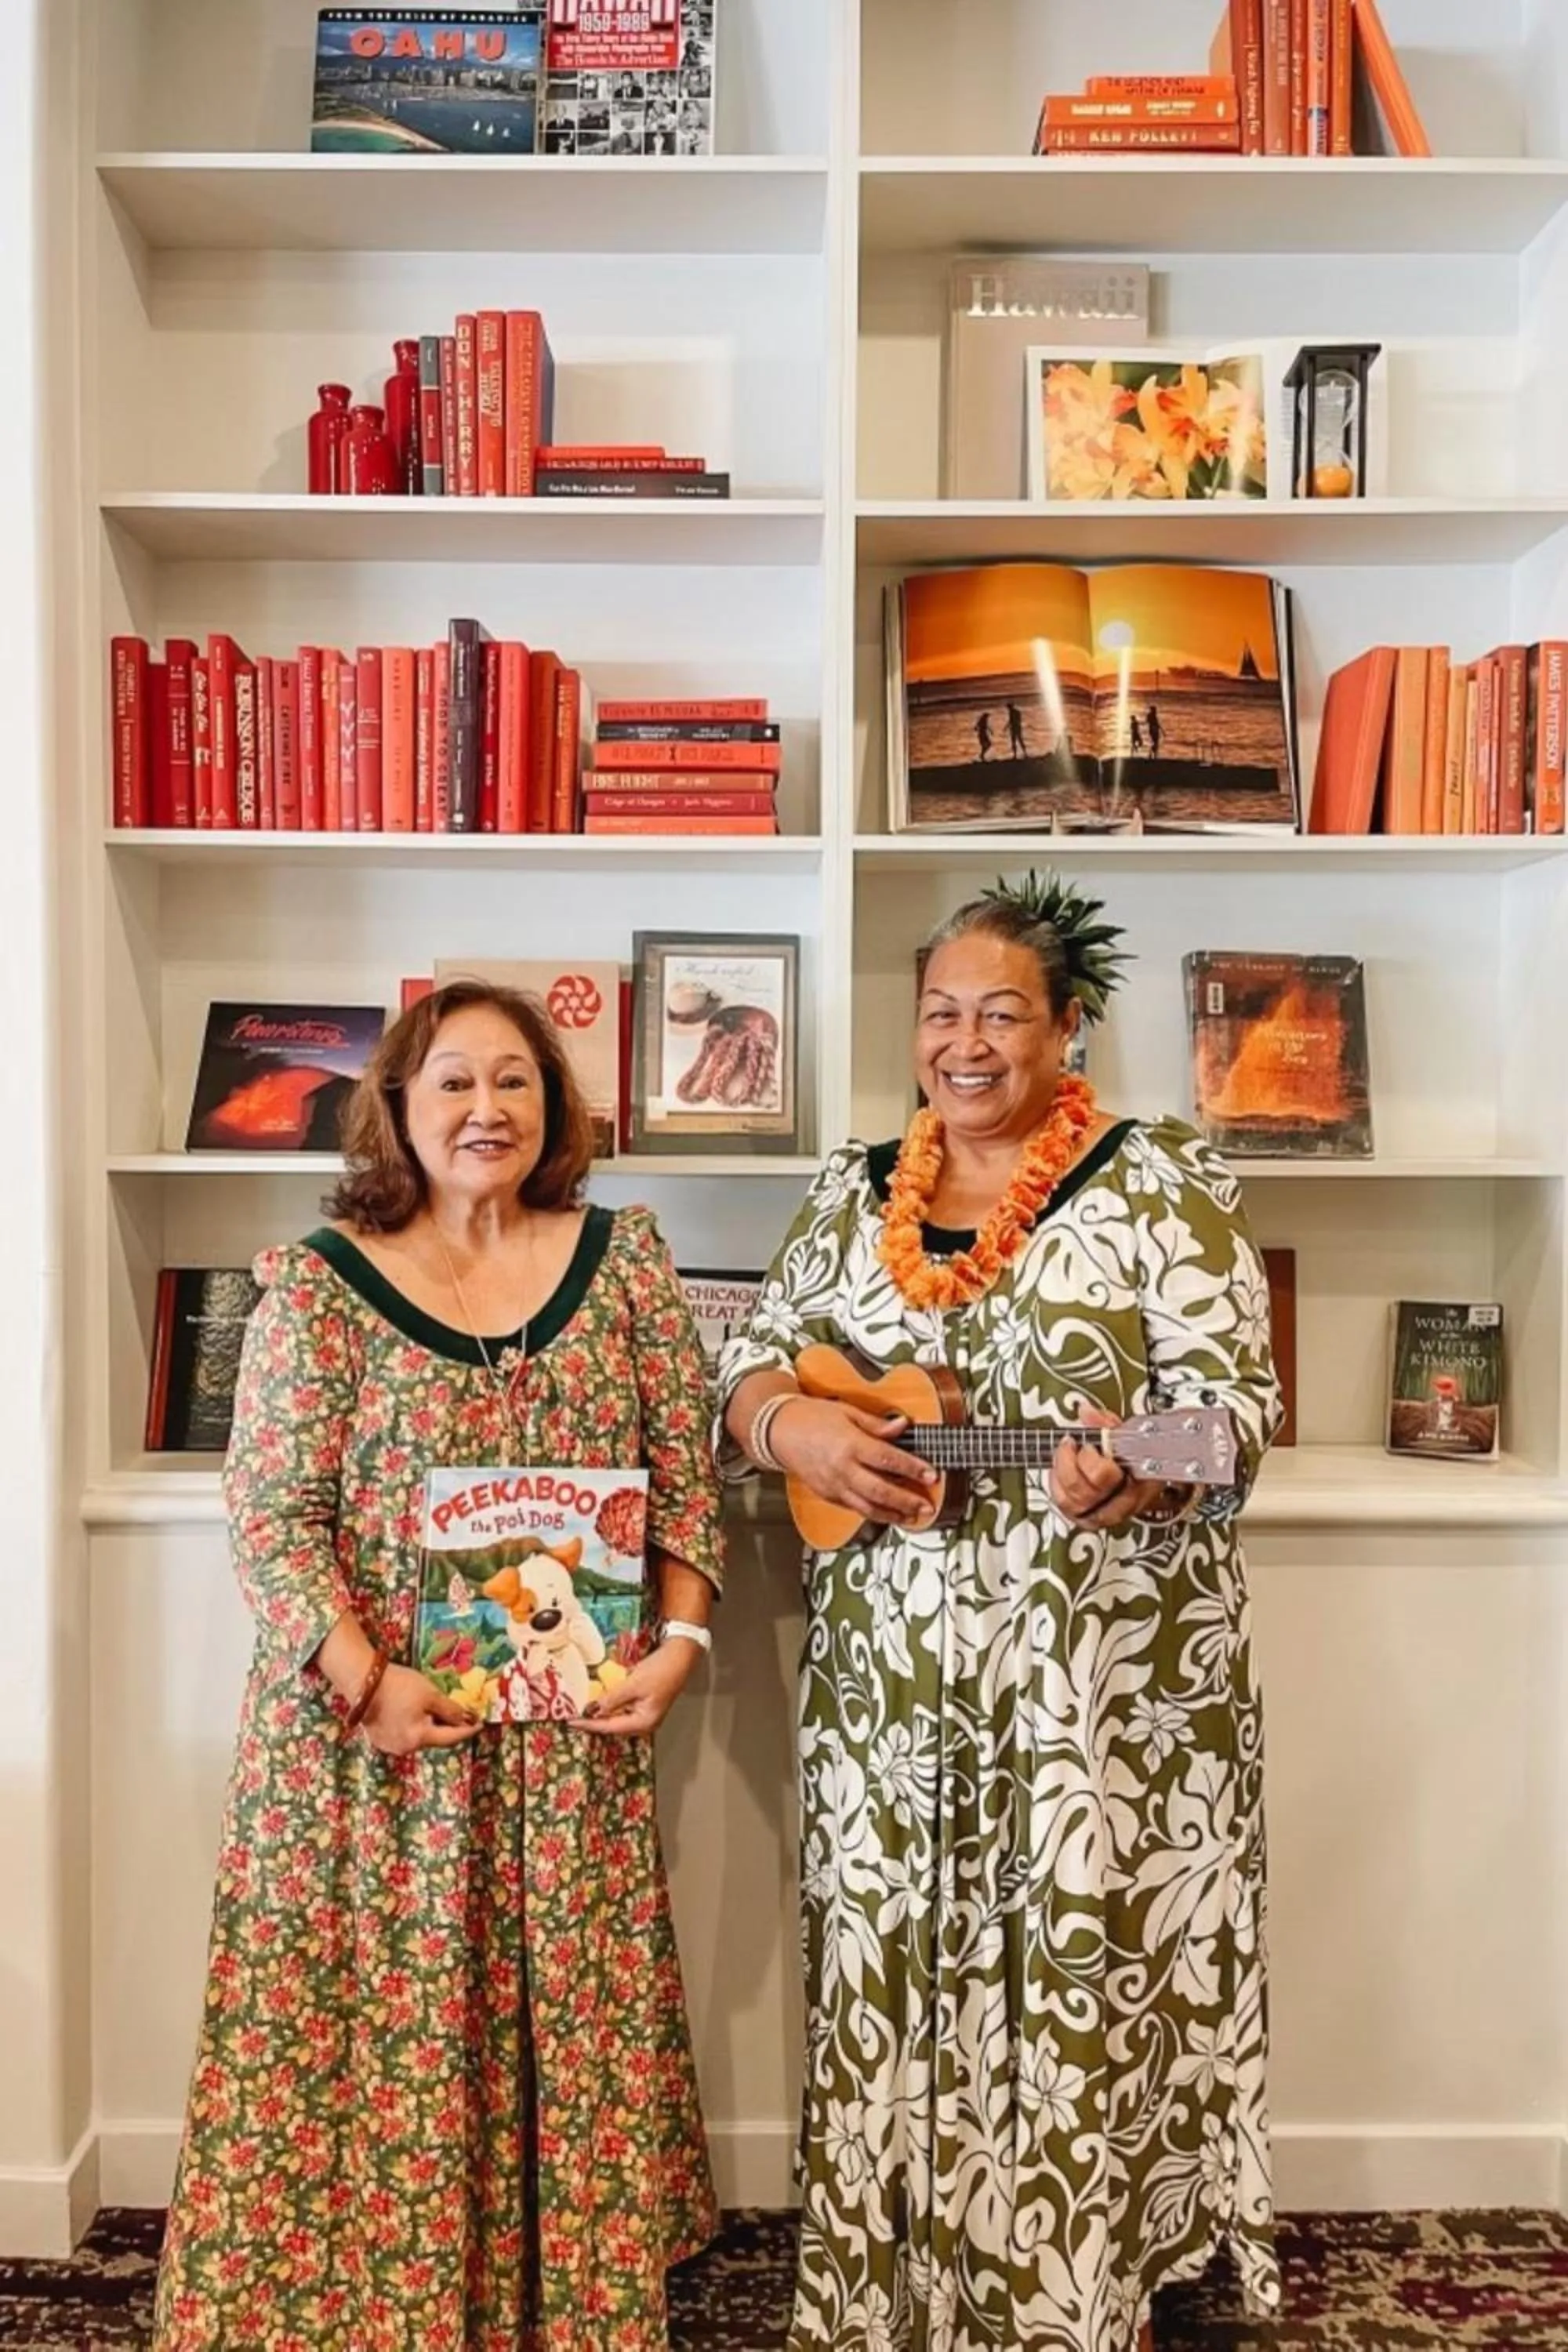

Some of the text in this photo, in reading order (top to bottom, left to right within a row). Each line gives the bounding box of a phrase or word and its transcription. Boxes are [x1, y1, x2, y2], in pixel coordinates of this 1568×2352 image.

[368, 12, 390, 20] THE
[461, 14, 527, 23] PARADISE
[579, 13, 650, 32] 1959-1989
[350, 26, 507, 61] OAHU
[1089, 131, 1123, 143] KEN
[967, 274, 1140, 320] Hawaii
[1546, 650, 1563, 769] JAMES PATTERSON
[235, 674, 254, 823] ROBINSON CRUSOE
[691, 1305, 739, 1320] REAT
[1419, 1338, 1481, 1355] WHITE
[1410, 1352, 1487, 1369] KIMONO
[431, 1475, 597, 1534] PEEKABOO
[471, 1507, 565, 1534] the Poi Dog
